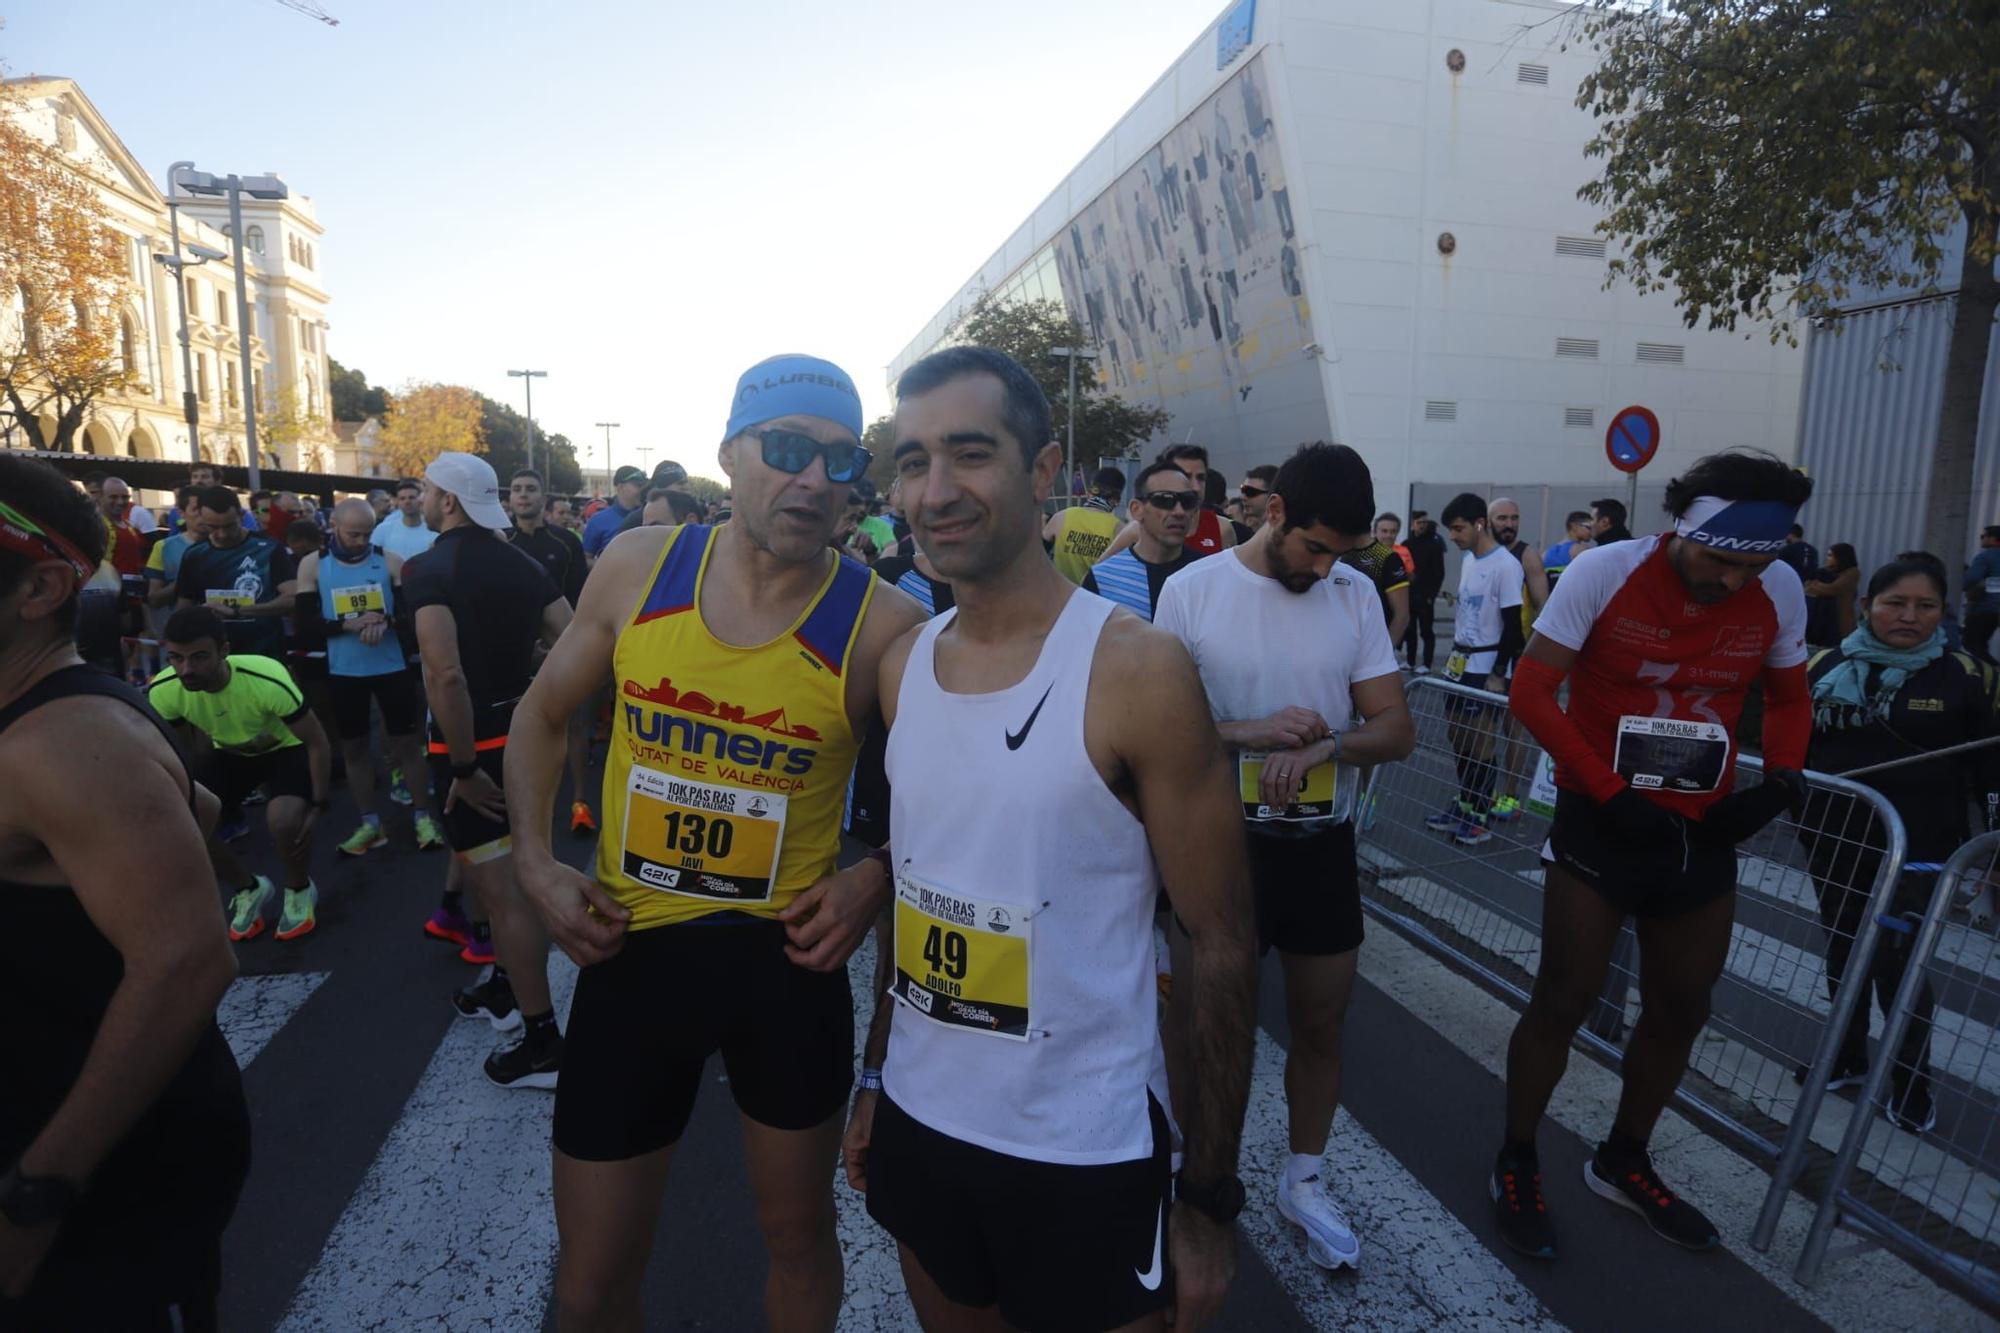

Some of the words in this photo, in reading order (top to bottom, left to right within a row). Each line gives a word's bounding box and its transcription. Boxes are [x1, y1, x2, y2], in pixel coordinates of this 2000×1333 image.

[1067, 530, 1110, 547] RUNNERS
[625, 702, 817, 775] runners
[1652, 721, 1665, 730] 10K
[1667, 722, 1681, 732] PAS
[1682, 725, 1698, 734] RAS
[681, 757, 707, 774] DE
[717, 765, 805, 792] VALÈNCIA
[1635, 776, 1660, 785] 42K
[668, 782, 687, 796] 10K
[690, 787, 711, 802] PAS
[713, 790, 736, 806] RAS
[675, 796, 693, 806] PORT
[664, 811, 733, 859] 130
[681, 856, 704, 870] JAVI
[643, 868, 677, 883] 42K
[920, 888, 934, 906] 10K
[935, 893, 952, 913] PAS
[954, 899, 975, 918] RAS
[924, 924, 968, 980] 49
[925, 973, 961, 997] ADOLFO
[910, 987, 930, 1007] 42K
